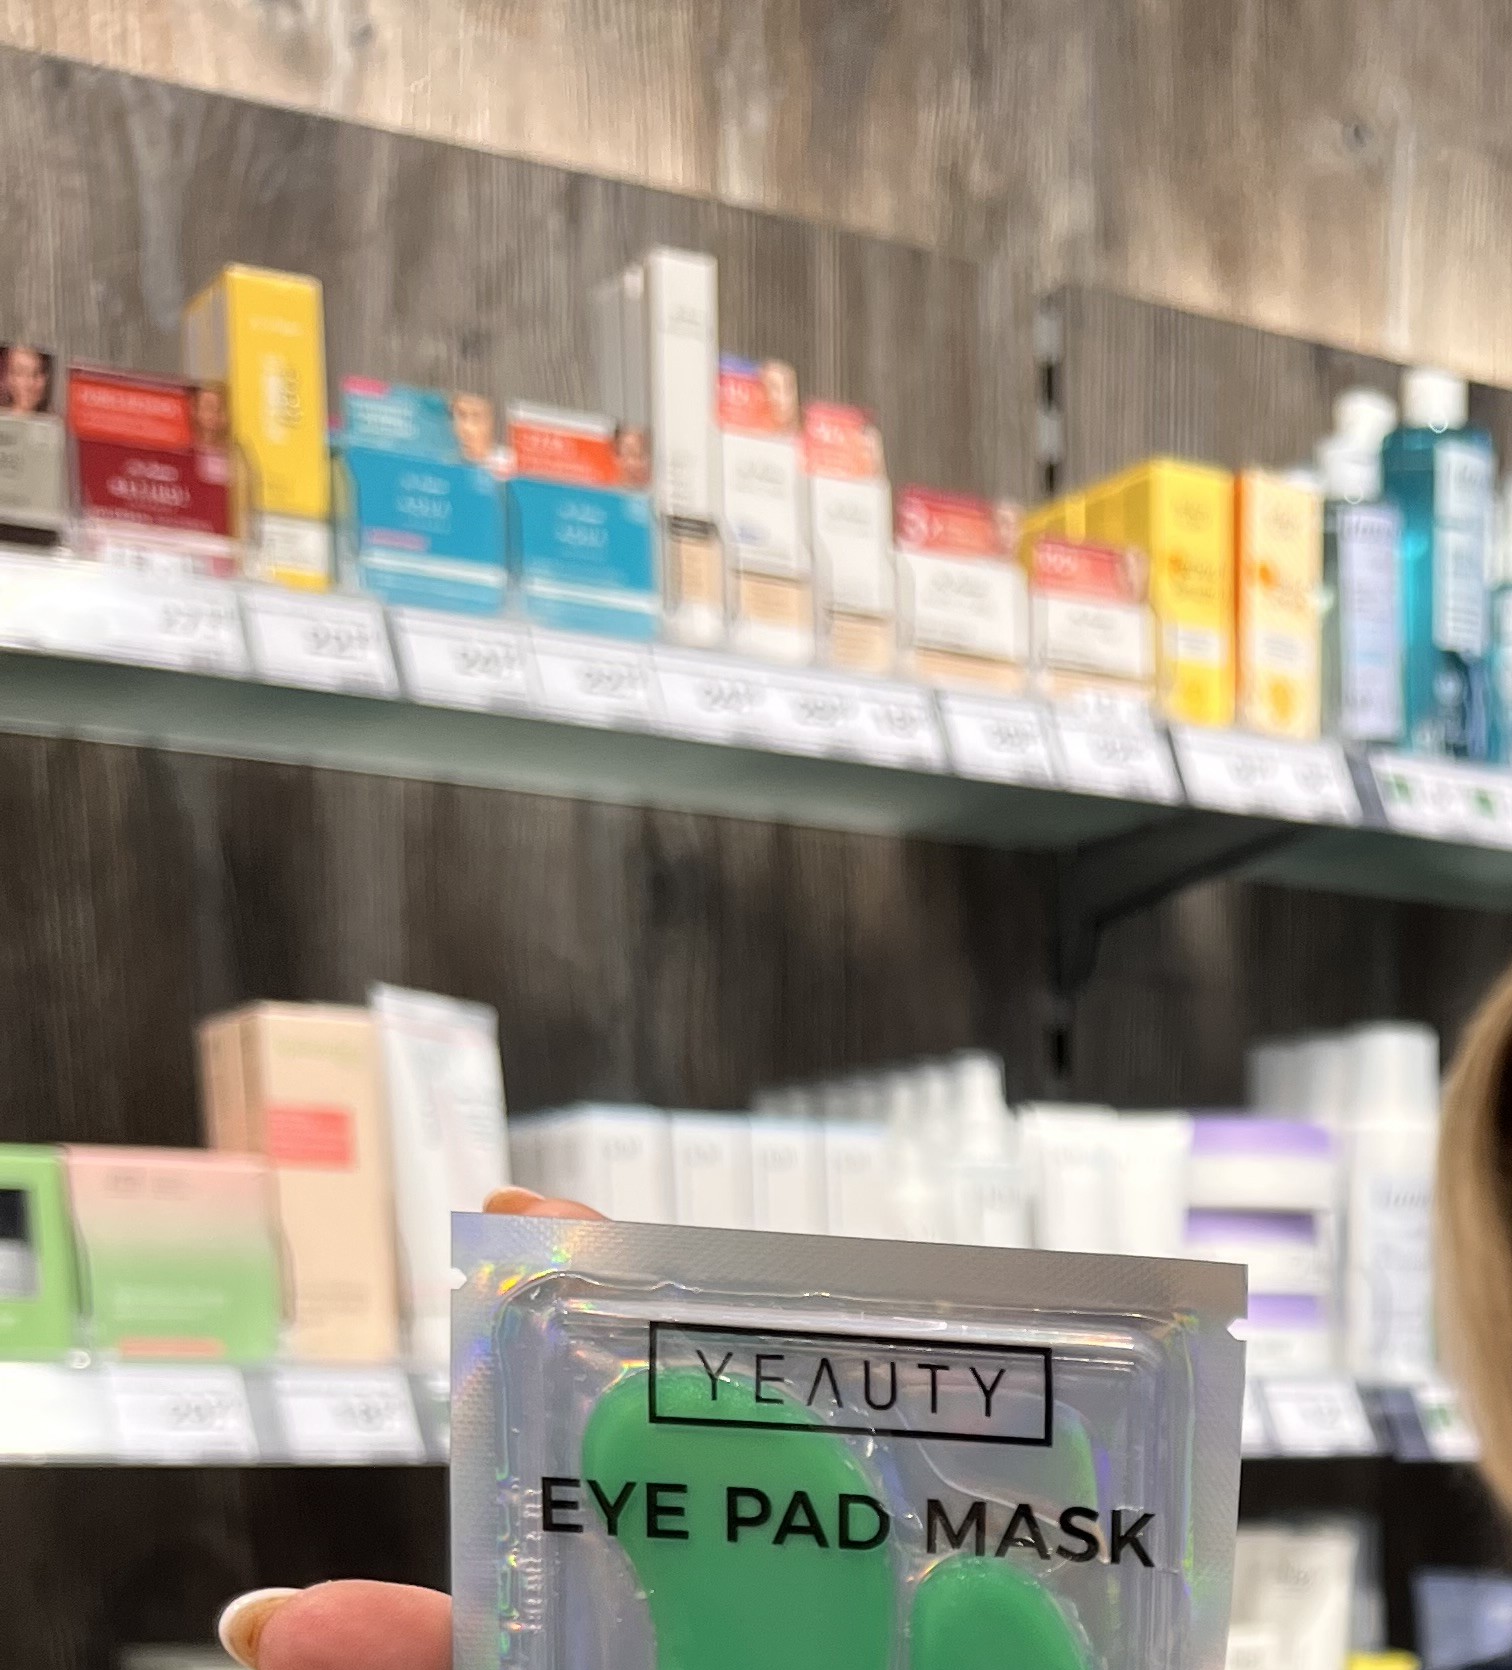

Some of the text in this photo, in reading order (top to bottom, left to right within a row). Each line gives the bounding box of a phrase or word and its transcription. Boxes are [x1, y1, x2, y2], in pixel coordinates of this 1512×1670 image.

[695, 1348, 1007, 1417] YEAUTY
[541, 1477, 1155, 1568] EYE PAD MASK
